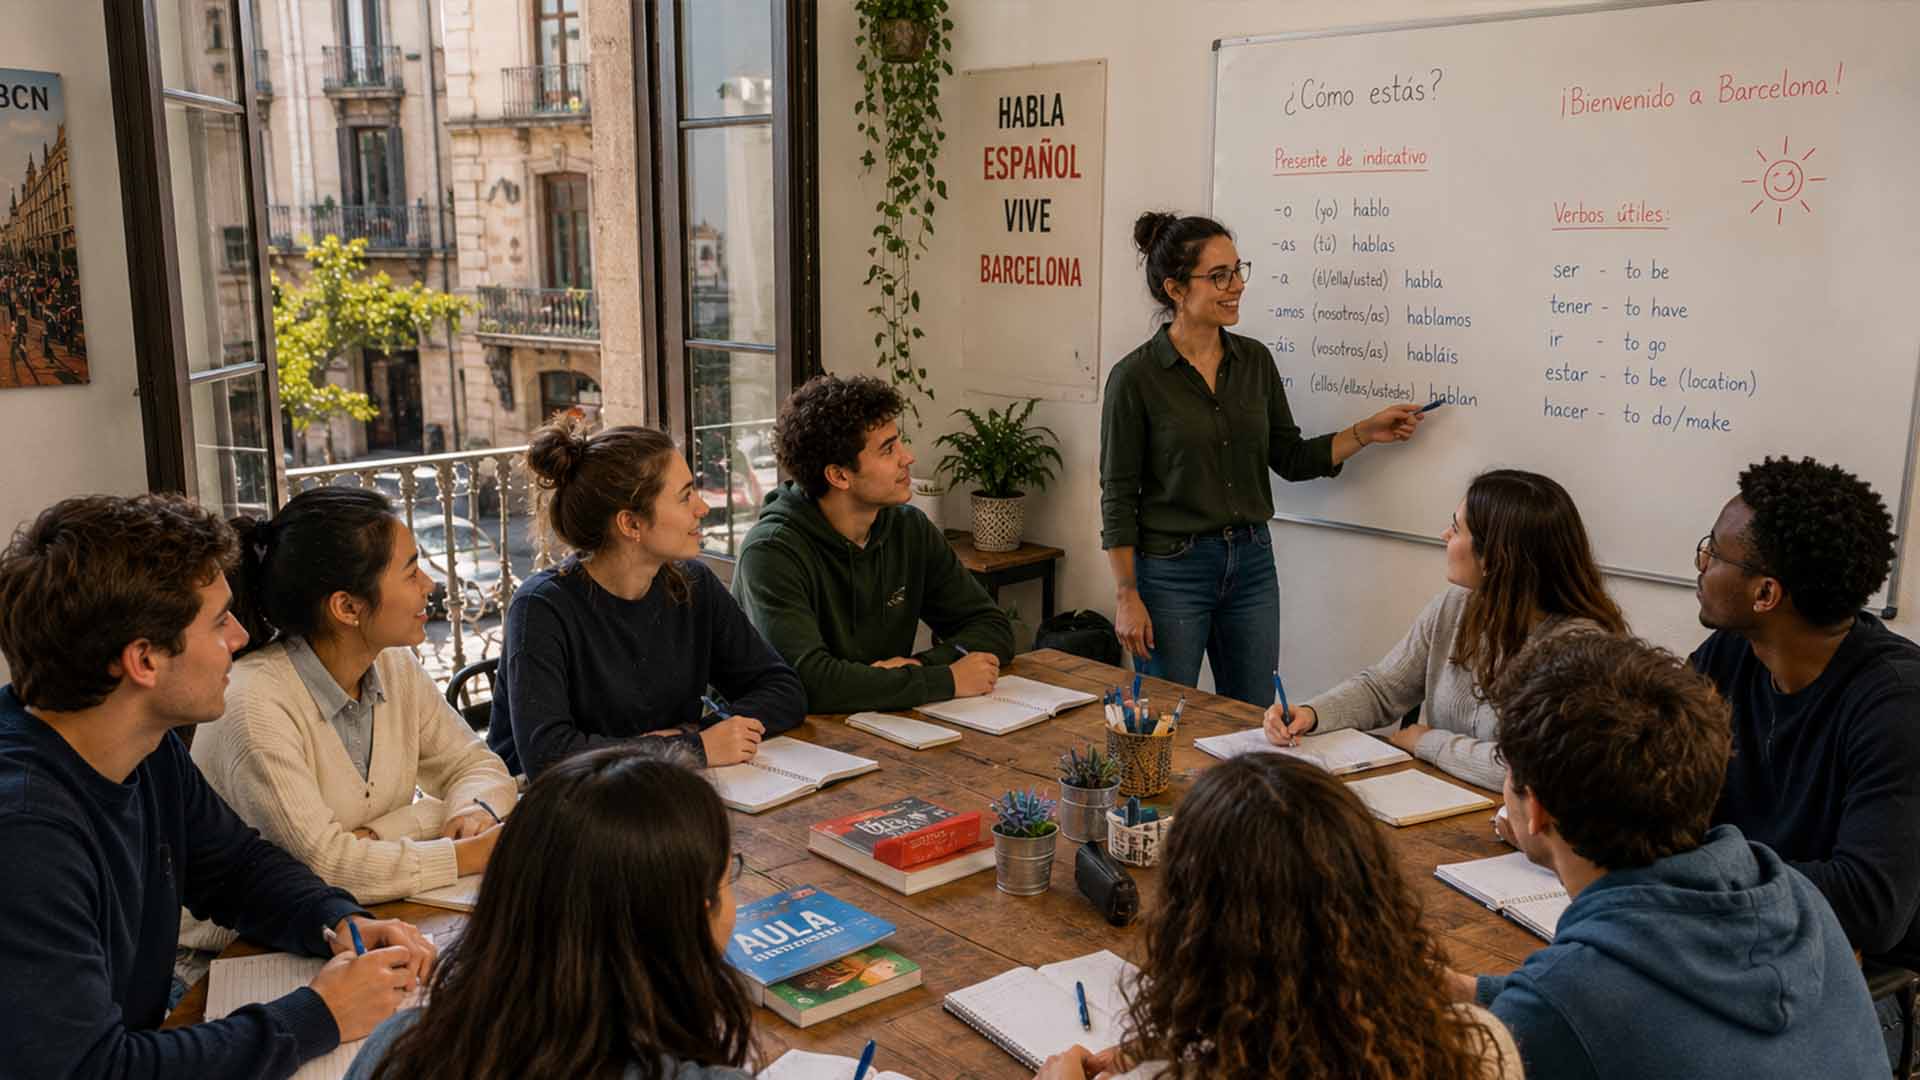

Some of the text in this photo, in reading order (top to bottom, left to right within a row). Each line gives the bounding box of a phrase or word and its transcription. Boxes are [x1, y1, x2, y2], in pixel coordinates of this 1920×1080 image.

[0, 84, 48, 111] BCN
[1285, 68, 1443, 115] ¿Cómo estás?
[1561, 61, 1844, 119] ¡Bienvenido a Barcelona!
[998, 93, 1064, 129] HABLA
[983, 138, 1081, 180] ESPAÑOL
[1275, 145, 1427, 169] Presente de indicativo
[1004, 198, 1051, 232] VIVE
[1273, 197, 1390, 223] -o (yo) hablo
[1553, 201, 1671, 224] Verbos útiles:
[1272, 232, 1396, 255] -as (tú) hablas
[980, 254, 1082, 287] BARCELONA
[1272, 268, 1444, 290] -a (él/ella/usted) habla
[1553, 263, 1580, 279] ser
[1625, 259, 1641, 279] to
[1651, 258, 1669, 280] be
[1267, 302, 1472, 328] -amos (nosotros/as) hablamos
[1550, 294, 1592, 314] tener
[1625, 296, 1641, 316] to
[1651, 296, 1689, 319] have
[1267, 335, 1459, 365] -áis (vosotros/as) habláis
[1550, 330, 1563, 348] ir
[1625, 332, 1640, 350] to
[1648, 338, 1666, 360] go
[1429, 381, 1478, 407] hablan
[1545, 363, 1589, 383] estar
[1625, 366, 1639, 385] to
[1649, 367, 1667, 388] be
[1679, 367, 1757, 396] (location)
[1544, 396, 1589, 419] hacer
[1624, 405, 1640, 423] to
[1652, 406, 1733, 432] do/make
[734, 909, 836, 955] AULA
